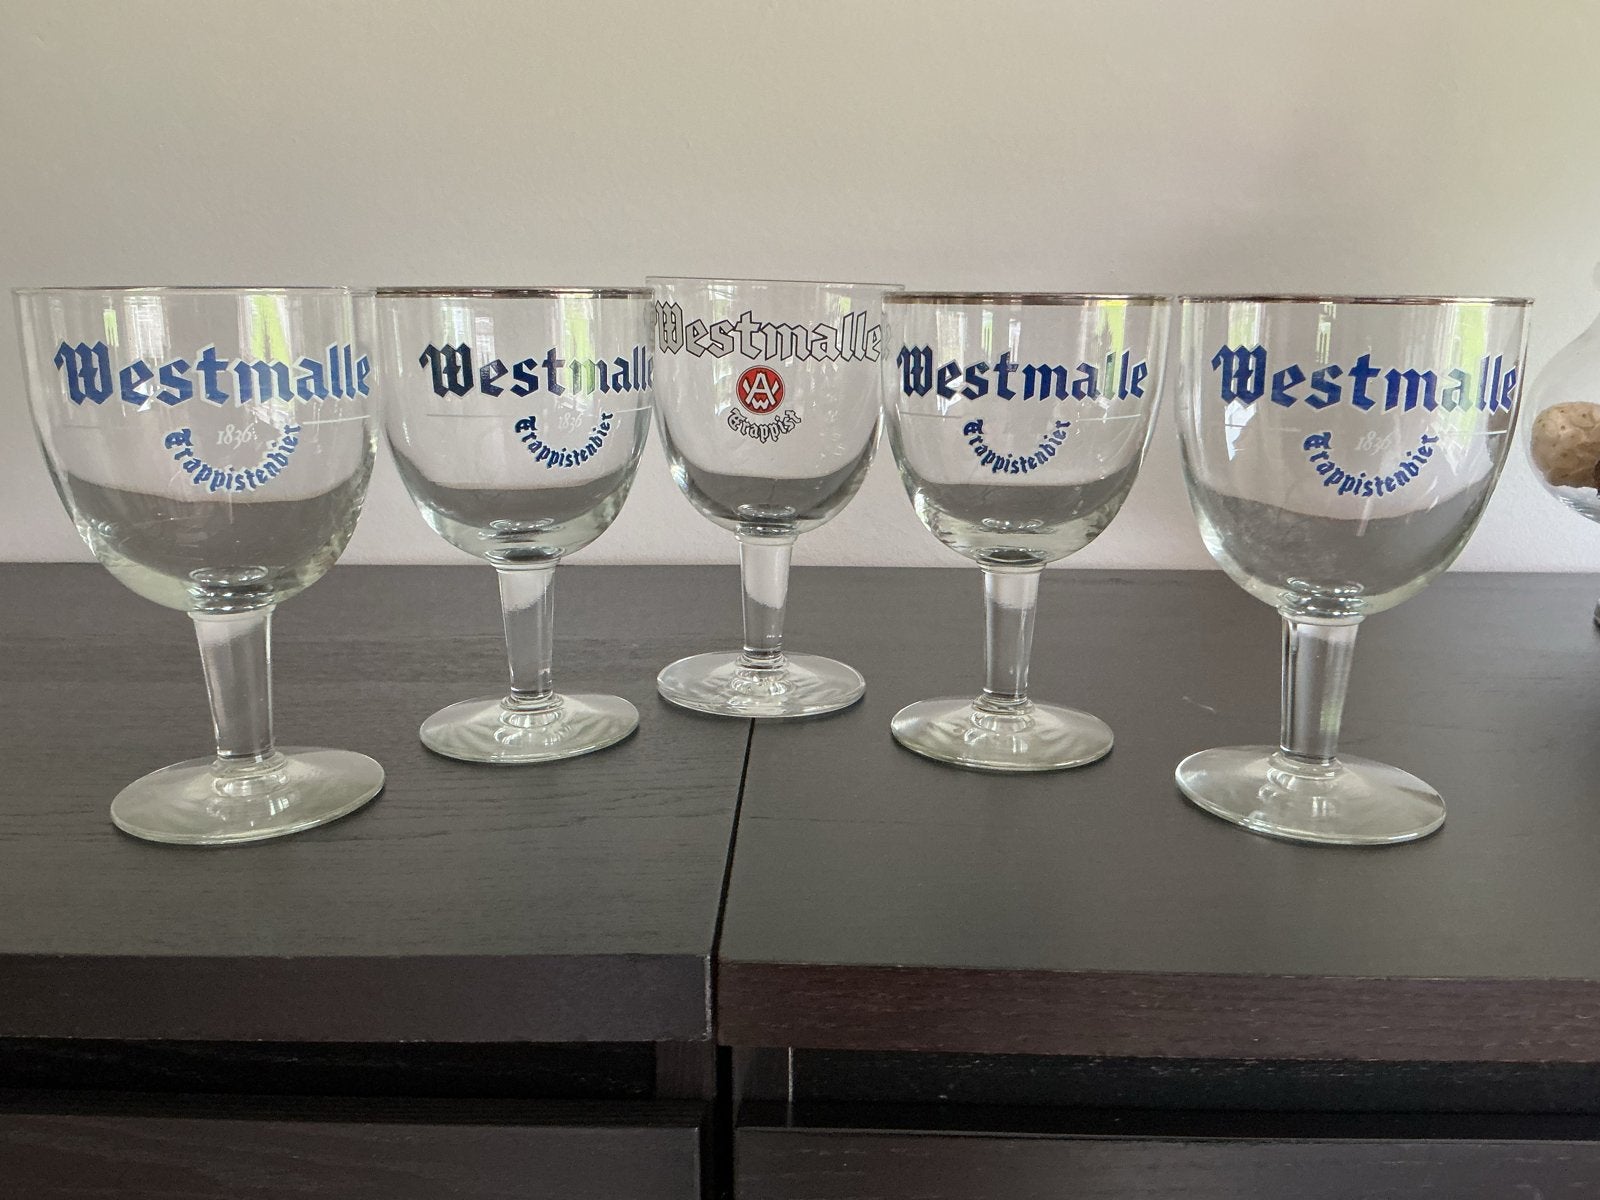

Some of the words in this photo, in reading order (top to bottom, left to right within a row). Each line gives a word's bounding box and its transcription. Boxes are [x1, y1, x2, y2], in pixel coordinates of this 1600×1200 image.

[654, 299, 882, 362] Westmalle
[53, 340, 371, 407] Westmalle
[896, 344, 1148, 401] Westmalle
[1211, 343, 1518, 414] Westmalle
[216, 423, 254, 450] 1836
[514, 411, 614, 470] Trappistenbier
[727, 407, 802, 444] Trappist
[963, 418, 1071, 475] Trappistenbier
[164, 424, 301, 492] Trappistenbier
[1303, 430, 1441, 499] Trappistenbier
